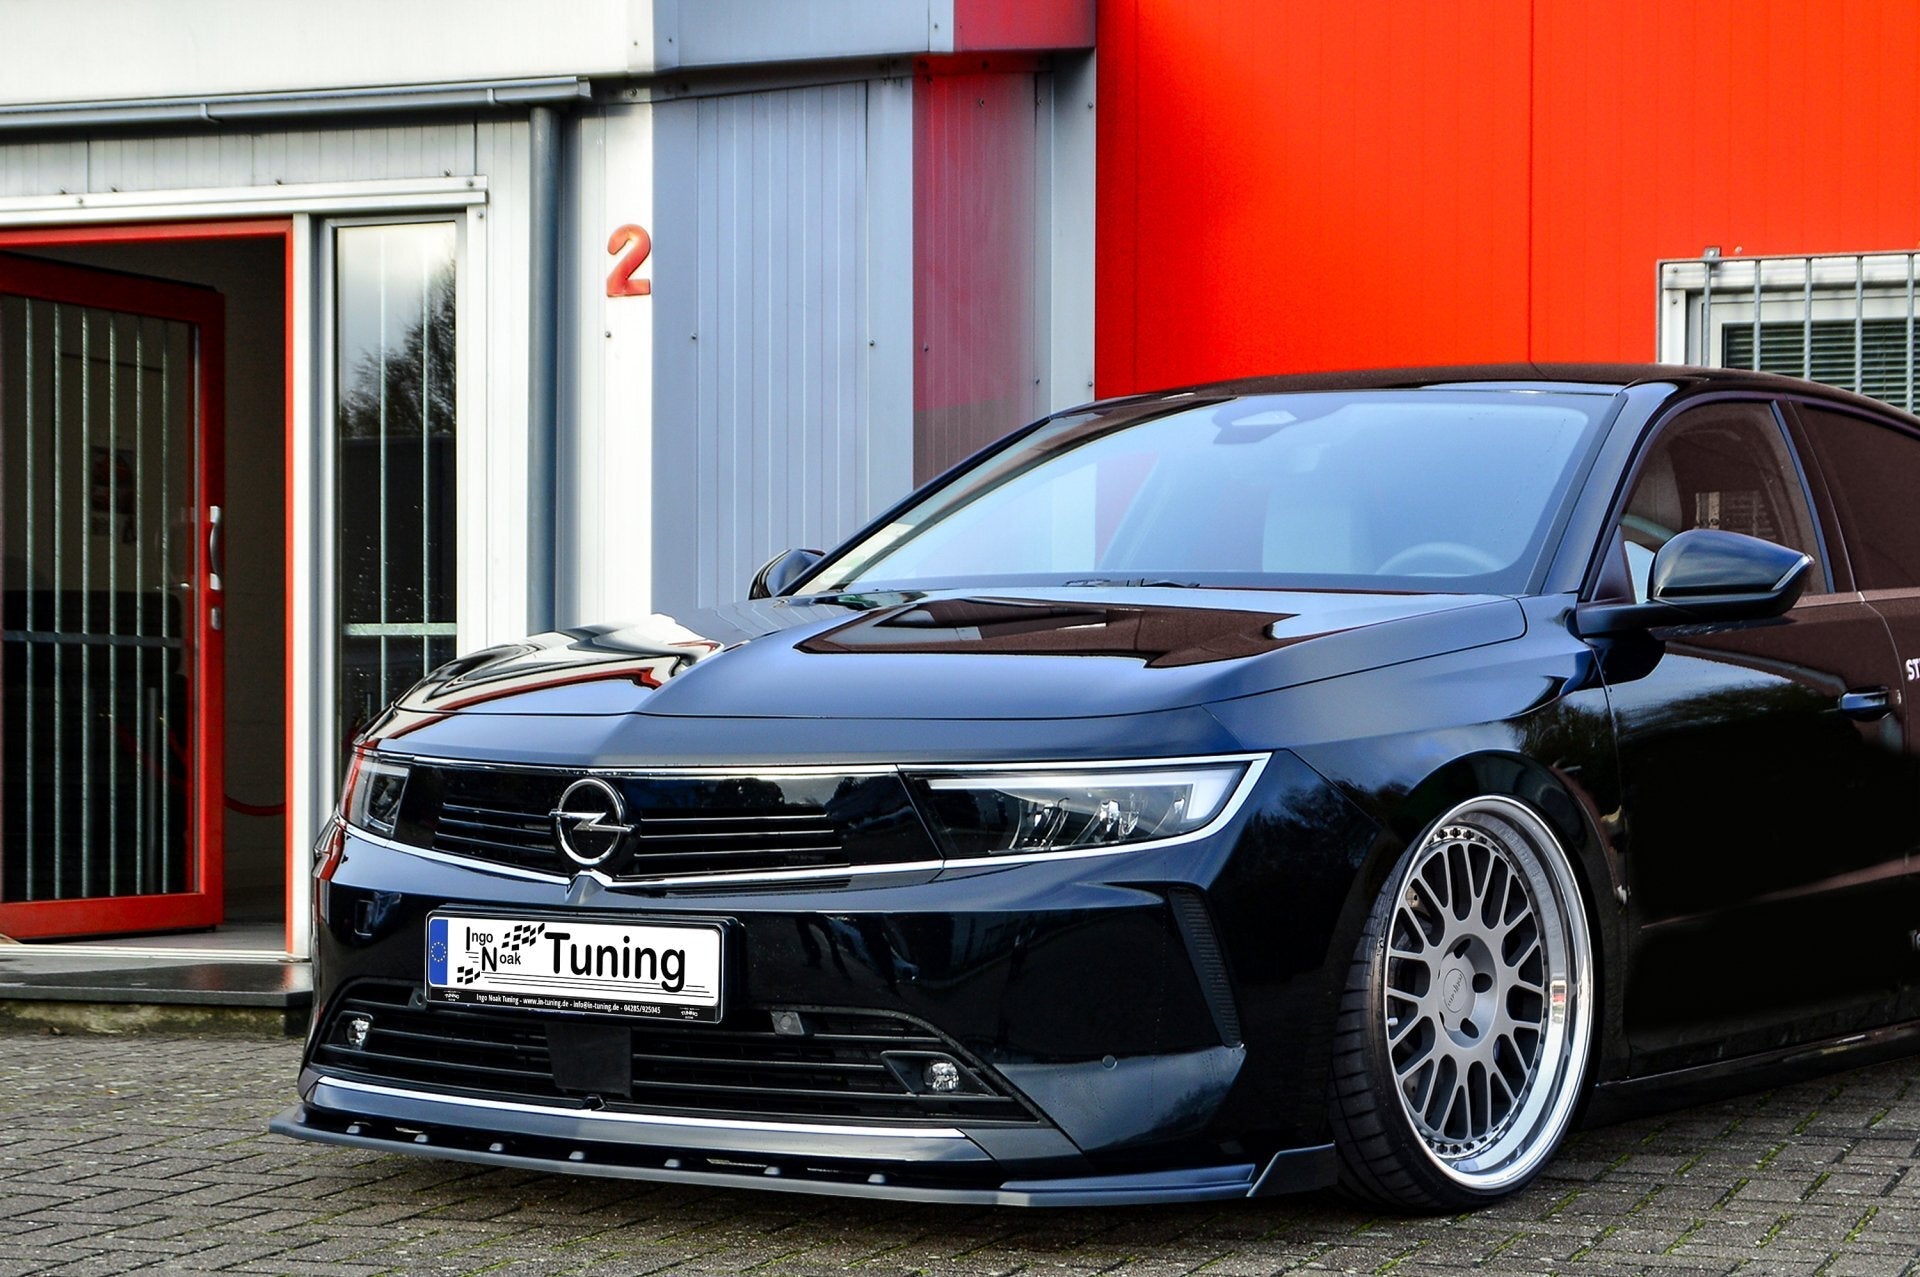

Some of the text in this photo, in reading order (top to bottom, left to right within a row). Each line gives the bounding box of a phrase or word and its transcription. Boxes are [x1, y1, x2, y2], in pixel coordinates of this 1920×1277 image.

[606, 223, 651, 297] 2
[466, 926, 493, 951] Ingo
[481, 946, 521, 972] Noak
[544, 932, 685, 993] Tuning
[476, 993, 488, 1003] Ingo
[488, 994, 502, 1002] Noak
[502, 995, 519, 1006] Tuning
[523, 998, 569, 1009] www.in-tuning.de
[573, 1000, 619, 1012] info@in-tuning.de
[623, 1005, 661, 1014] 04285/925045
